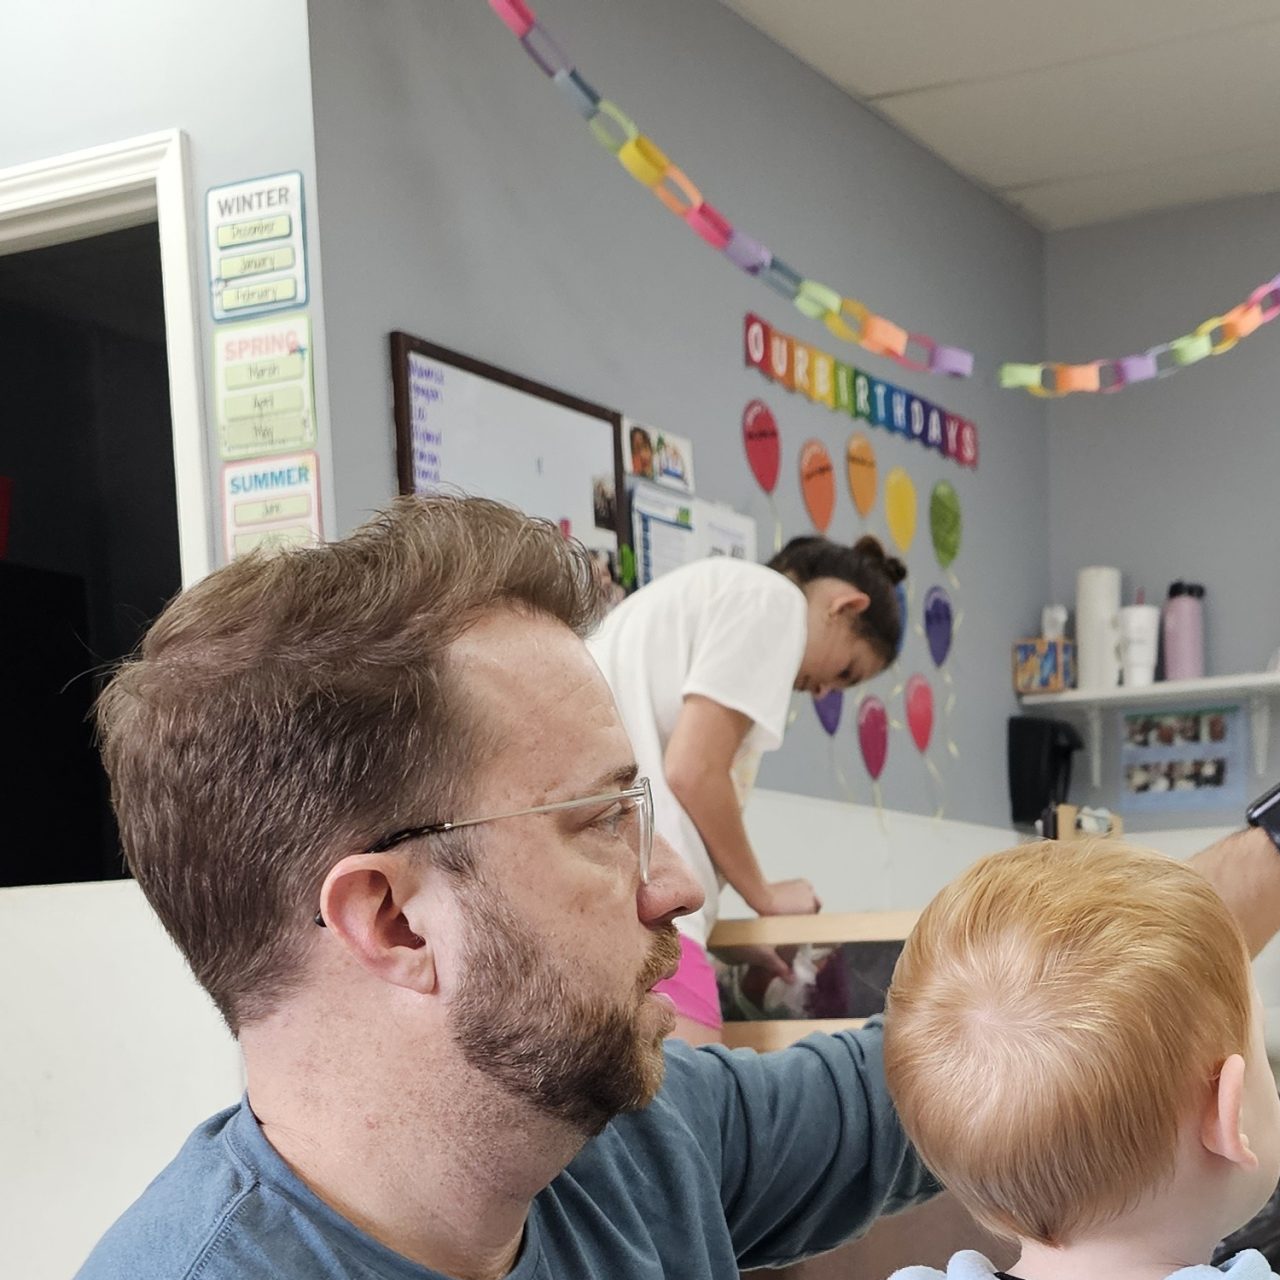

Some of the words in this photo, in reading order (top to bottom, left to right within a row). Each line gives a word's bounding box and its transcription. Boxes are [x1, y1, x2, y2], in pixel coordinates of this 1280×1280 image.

[217, 187, 290, 217] WINTER
[240, 255, 276, 273] January
[236, 283, 277, 304] February
[225, 331, 299, 361] SPRING
[231, 466, 309, 494] SUMMER
